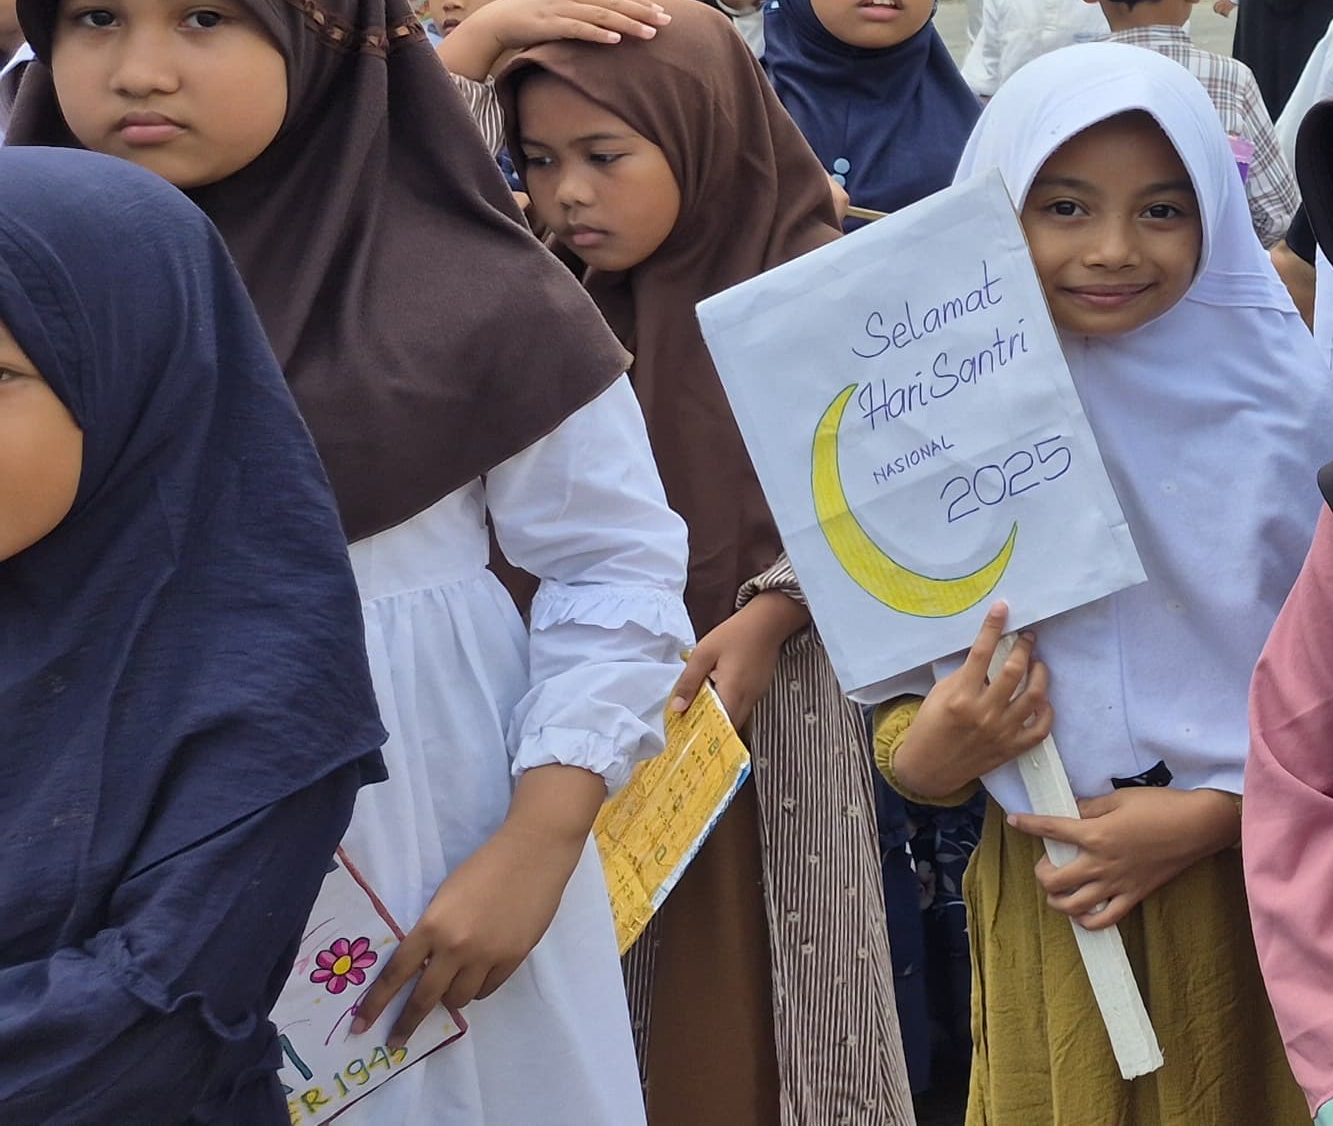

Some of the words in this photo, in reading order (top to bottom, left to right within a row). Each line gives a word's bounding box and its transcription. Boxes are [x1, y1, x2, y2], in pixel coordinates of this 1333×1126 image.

[851, 259, 1005, 359] Selamat
[872, 434, 955, 485] NASIONAL
[939, 434, 1072, 524] 2025
